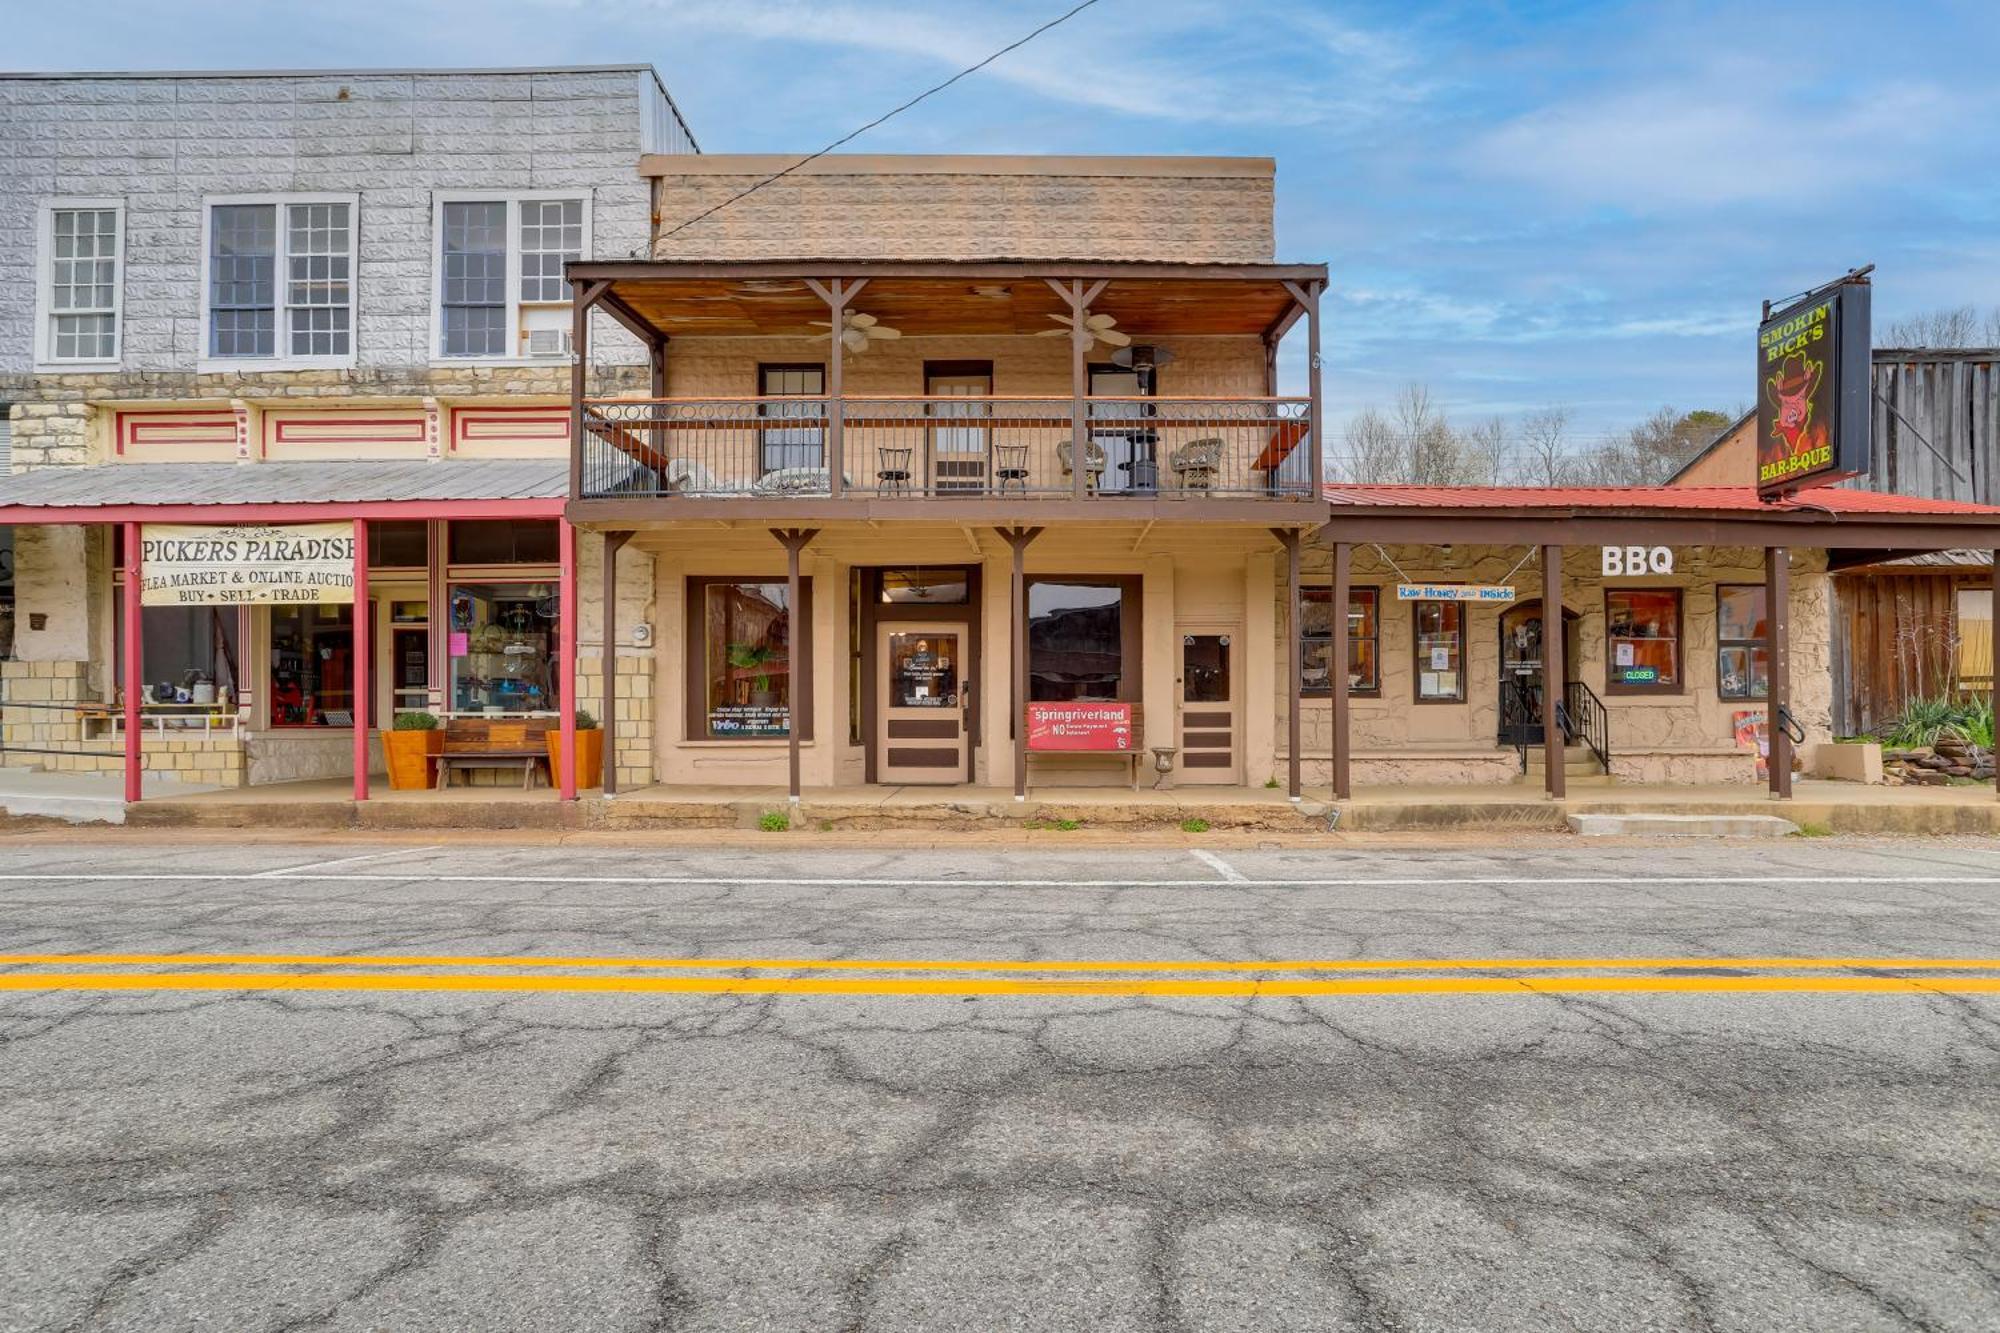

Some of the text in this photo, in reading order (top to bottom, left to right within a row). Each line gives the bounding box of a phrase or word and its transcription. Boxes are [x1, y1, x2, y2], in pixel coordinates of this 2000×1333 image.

[1760, 303, 1831, 349] SMOKIN'
[1767, 324, 1824, 363] RICK'S
[142, 540, 238, 562] PICKERS
[1602, 546, 1674, 576] BBQ
[171, 572, 227, 587] MARKET
[232, 571, 245, 583] &
[249, 571, 304, 584] ONLINE
[307, 572, 354, 588] AUCTIO
[179, 588, 320, 602] BUY SELL TRADE
[1626, 671, 1654, 679] CLOSED
[1035, 709, 1125, 723] springriverland
[712, 719, 740, 730] Vrbo
[1052, 724, 1066, 736] NO
